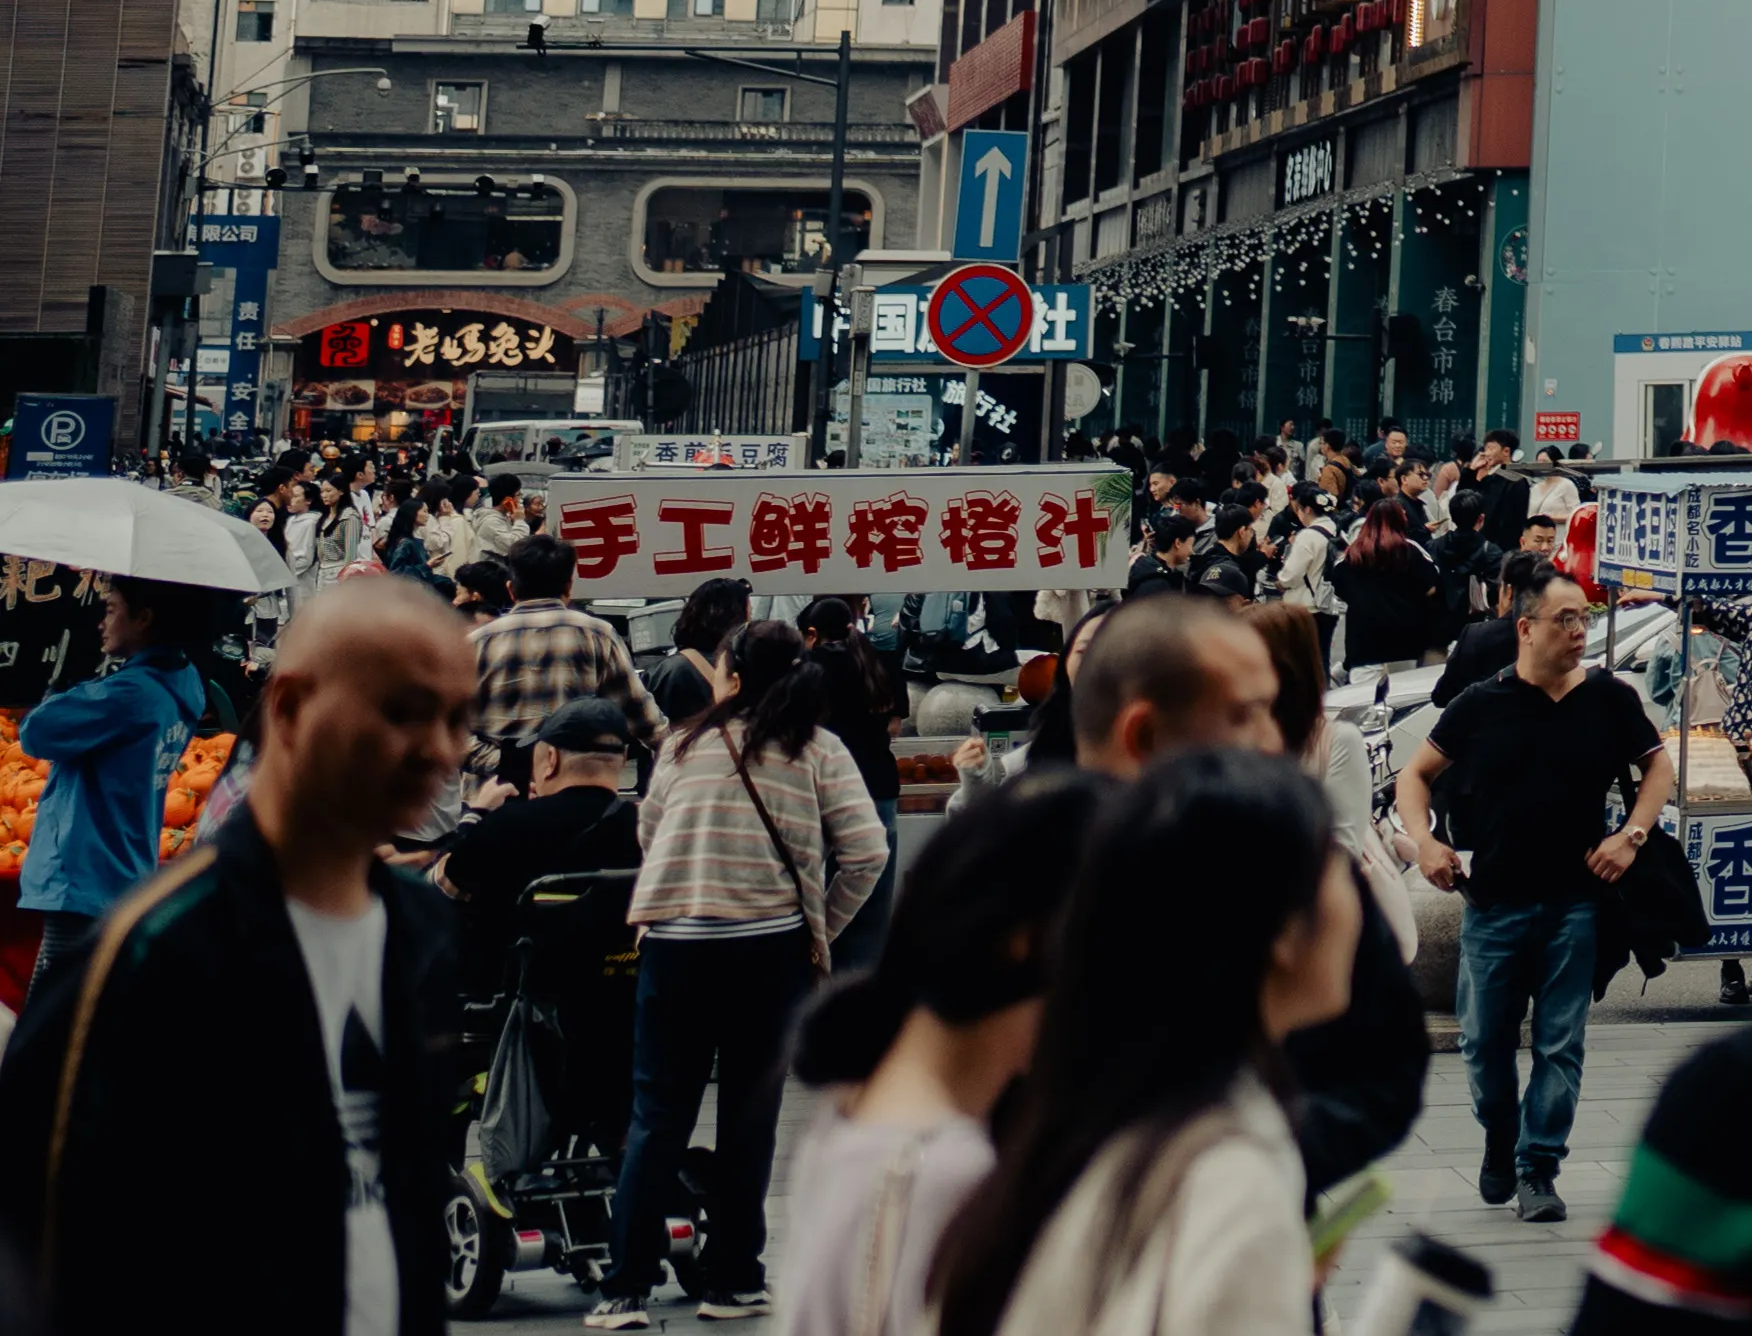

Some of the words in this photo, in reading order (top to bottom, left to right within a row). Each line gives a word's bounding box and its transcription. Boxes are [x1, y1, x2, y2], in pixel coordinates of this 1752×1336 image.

[1428, 285, 1460, 405] 春台市锦
[560, 489, 1112, 580] 手工鲜榨橙汁
[1684, 483, 1702, 568] 成都名小吃
